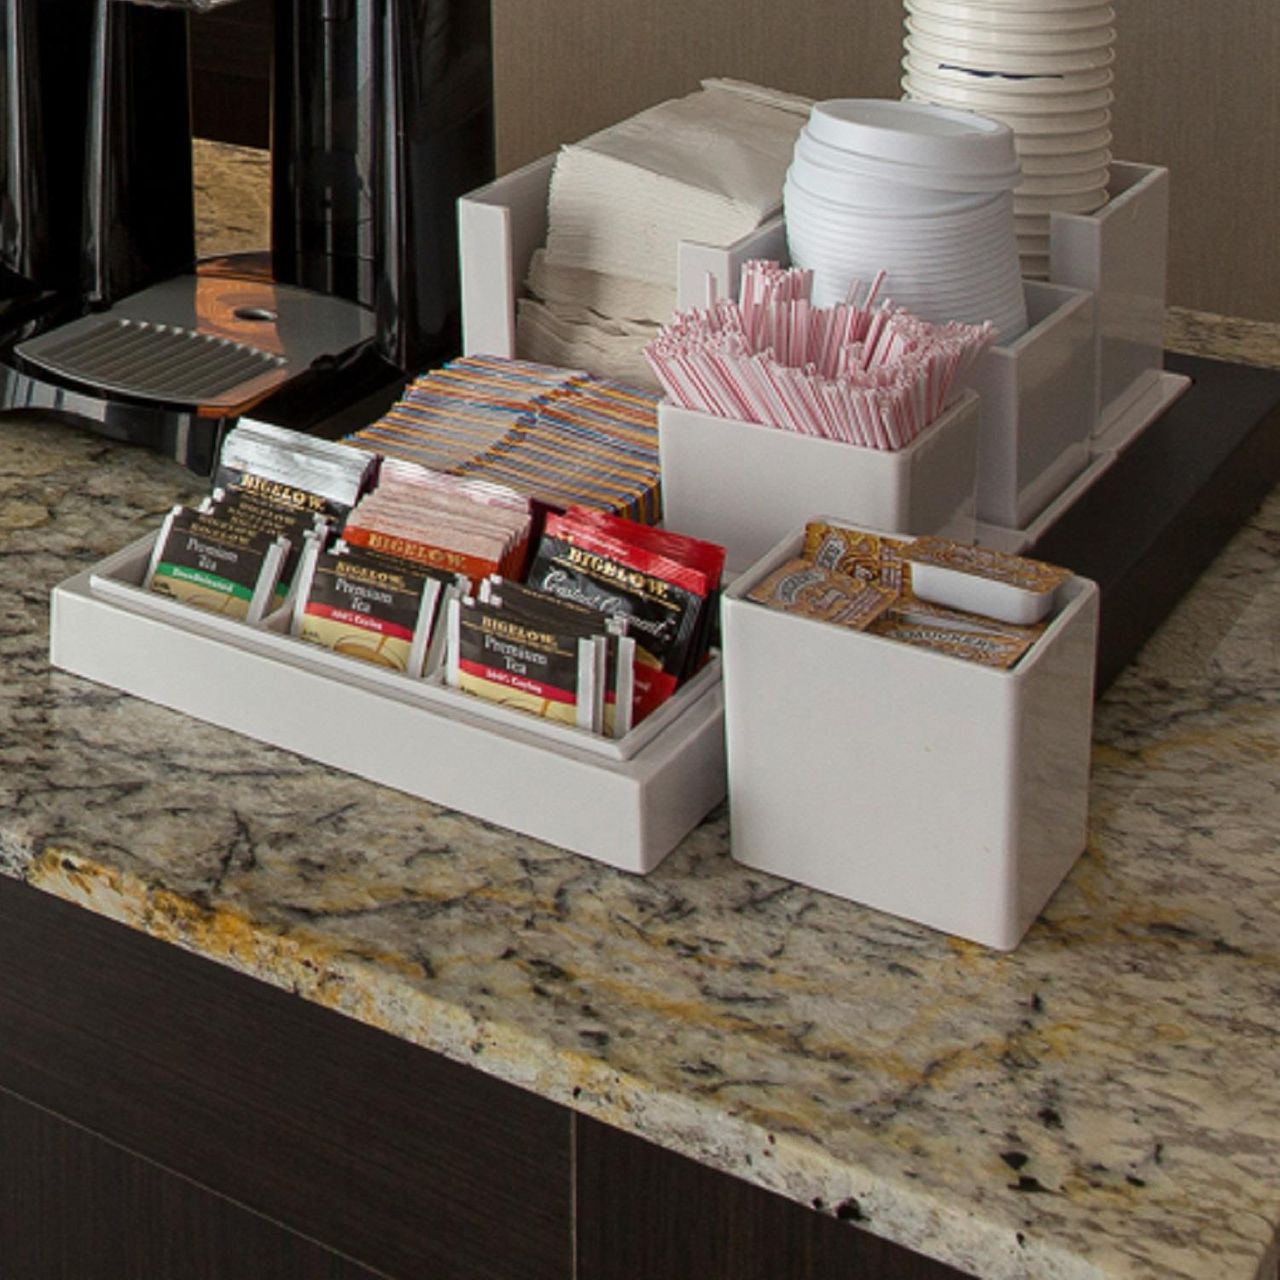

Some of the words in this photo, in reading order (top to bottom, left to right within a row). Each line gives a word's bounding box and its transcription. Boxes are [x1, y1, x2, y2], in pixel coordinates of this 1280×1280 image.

[186, 537, 239, 563] Premium
[198, 553, 218, 571] Tea
[367, 532, 468, 570] BIGELOW
[568, 546, 670, 599] BIGELOW
[335, 578, 393, 605] Premium
[351, 596, 372, 614] Tea
[482, 615, 556, 646] BIGELOW
[484, 634, 548, 665] Premium
[503, 655, 527, 676] Tea
